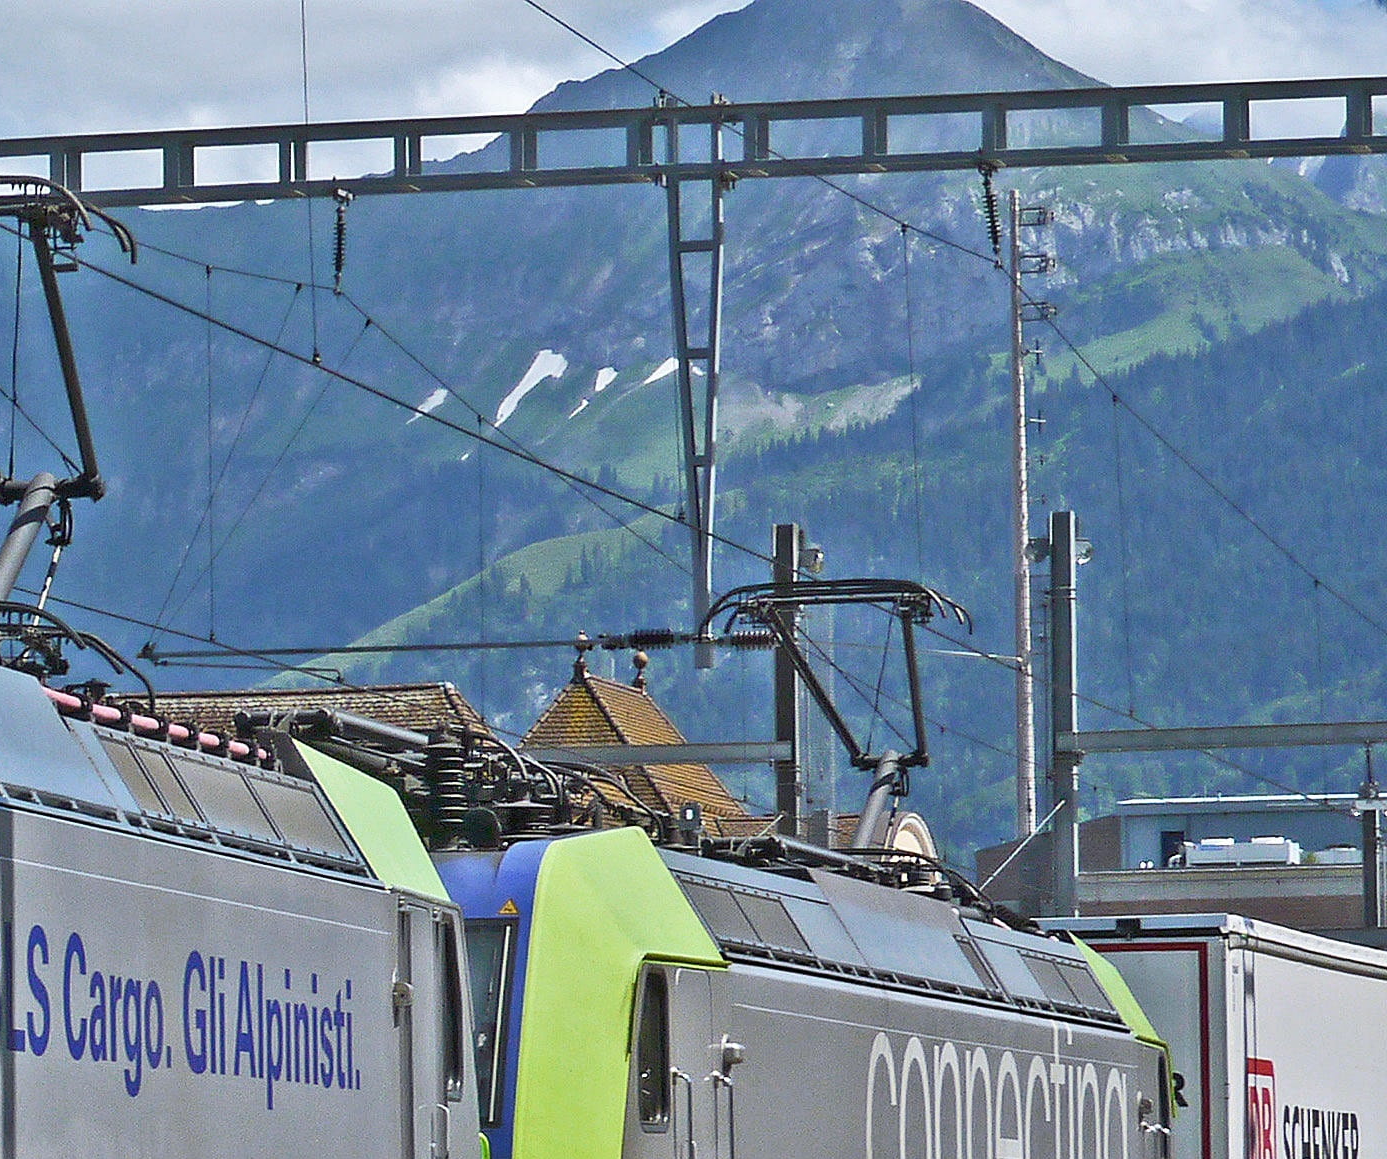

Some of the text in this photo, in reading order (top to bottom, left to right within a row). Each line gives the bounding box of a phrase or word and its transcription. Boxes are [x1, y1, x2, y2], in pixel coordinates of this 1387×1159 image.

[64, 931, 172, 1097] Cargo.
[182, 949, 227, 1075] Gli
[233, 960, 361, 1111] Alpinisti.
